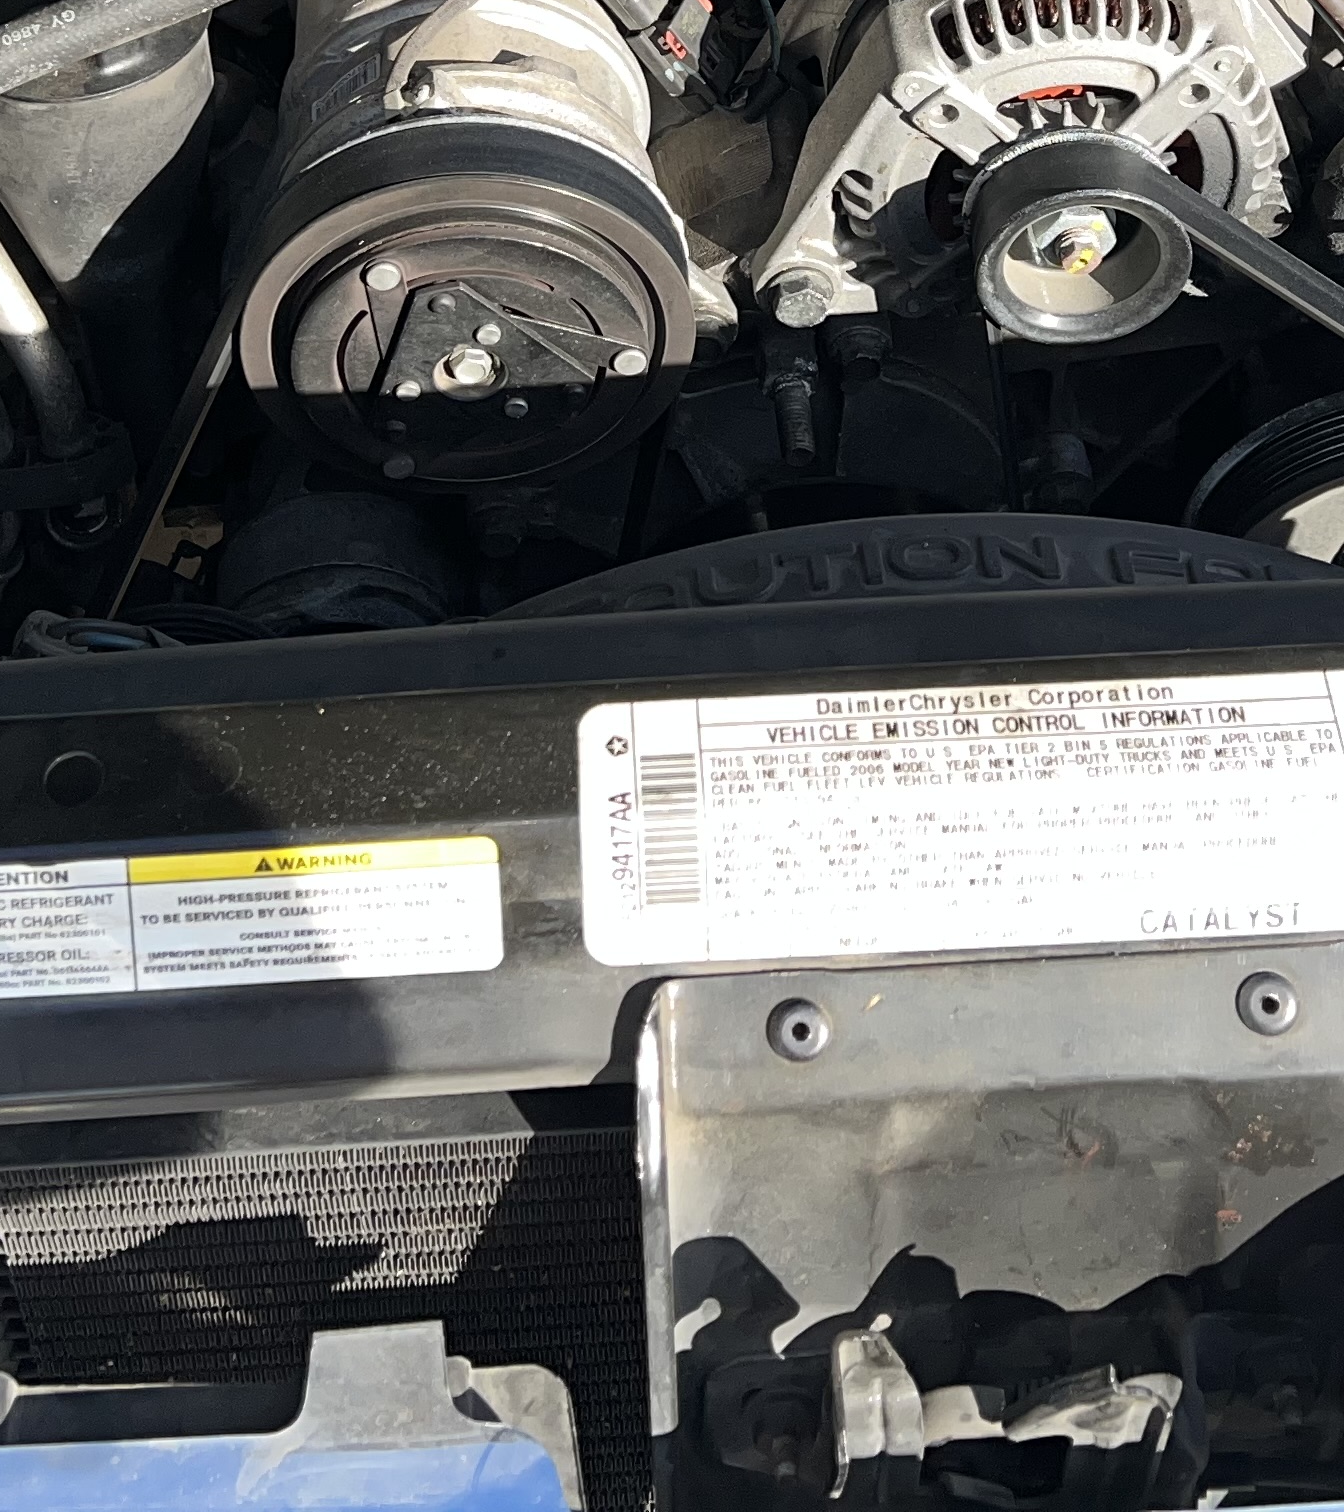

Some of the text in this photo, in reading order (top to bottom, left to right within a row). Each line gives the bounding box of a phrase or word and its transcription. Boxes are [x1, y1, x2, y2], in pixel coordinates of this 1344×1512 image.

[51, 9, 76, 29] GY
[1, 23, 42, 46] 4860
[584, 534, 1060, 610] AUTION
[817, 684, 1174, 716] DaimlerChrysler Corporation
[767, 707, 1246, 743] VEHICLE EMISSION CONTROL INFORMATION
[710, 755, 744, 767] THIS
[753, 752, 812, 766] VEHICLE
[822, 749, 892, 763] CONFORMS
[901, 747, 917, 759] TO
[969, 744, 996, 756] EPA
[1006, 741, 1039, 755] TIER
[1065, 740, 1092, 753] BIN
[1115, 734, 1212, 749] REGULATIONS
[1221, 730, 1306, 746] APPLICABLE
[1316, 728, 1333, 740] TO
[711, 770, 778, 782] GASOLINE
[789, 766, 842, 779] FUELED
[850, 764, 885, 776] 2006
[893, 761, 935, 773] MODEL
[946, 759, 980, 772] YEAR
[989, 757, 1015, 769] NEW
[1023, 752, 1110, 769] LIGHT-DUTY
[1120, 749, 1172, 763] TRUCKS
[1180, 747, 1207, 761] AND
[1214, 745, 1259, 759] MEETS
[1310, 742, 1337, 755] EPA
[276, 852, 373, 871] WARNING
[10, 893, 114, 911] REFRIGERANT
[177, 888, 292, 908] HIGH-PRESSURE
[21, 914, 89, 930] CHARGE:
[140, 914, 159, 926] TO
[163, 912, 181, 924] BE
[184, 908, 254, 924] SERVICED
[258, 907, 275, 920] BY
[239, 929, 291, 942] CONSULT
[61, 948, 91, 962] OIL:
[147, 949, 205, 961] IMPROPER
[208, 946, 254, 958] SERVICE
[257, 942, 311, 955] METHODS
[313, 940, 338, 952] MAY
[143, 962, 186, 975] SYSTEM
[189, 960, 227, 972] MEETS
[229, 957, 270, 970] SAFETY
